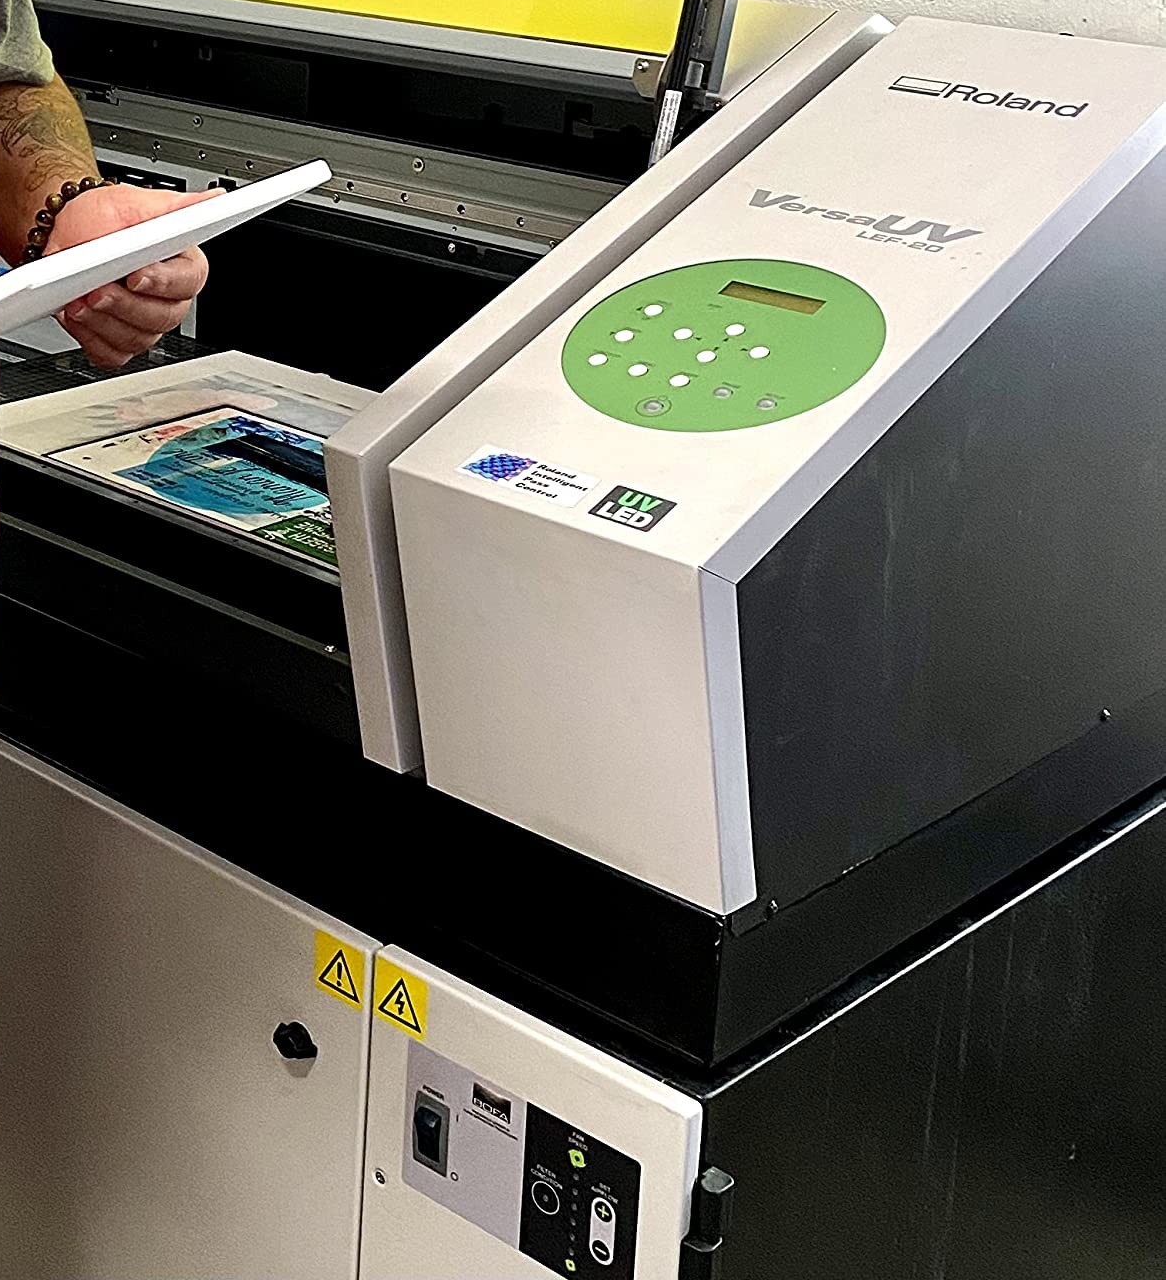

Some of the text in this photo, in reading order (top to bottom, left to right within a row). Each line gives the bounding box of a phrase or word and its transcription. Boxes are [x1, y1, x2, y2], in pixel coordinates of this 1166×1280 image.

[943, 84, 1089, 118] Roland
[749, 189, 984, 243] VersaUV
[523, 476, 550, 488] Pass
[531, 471, 588, 491] Intelligent
[537, 464, 577, 479] Roland
[515, 482, 558, 498] Control
[617, 490, 663, 512] UV
[595, 501, 654, 528] LED
[473, 1097, 509, 1123] BOFA
[536, 1164, 556, 1179] FILTER
